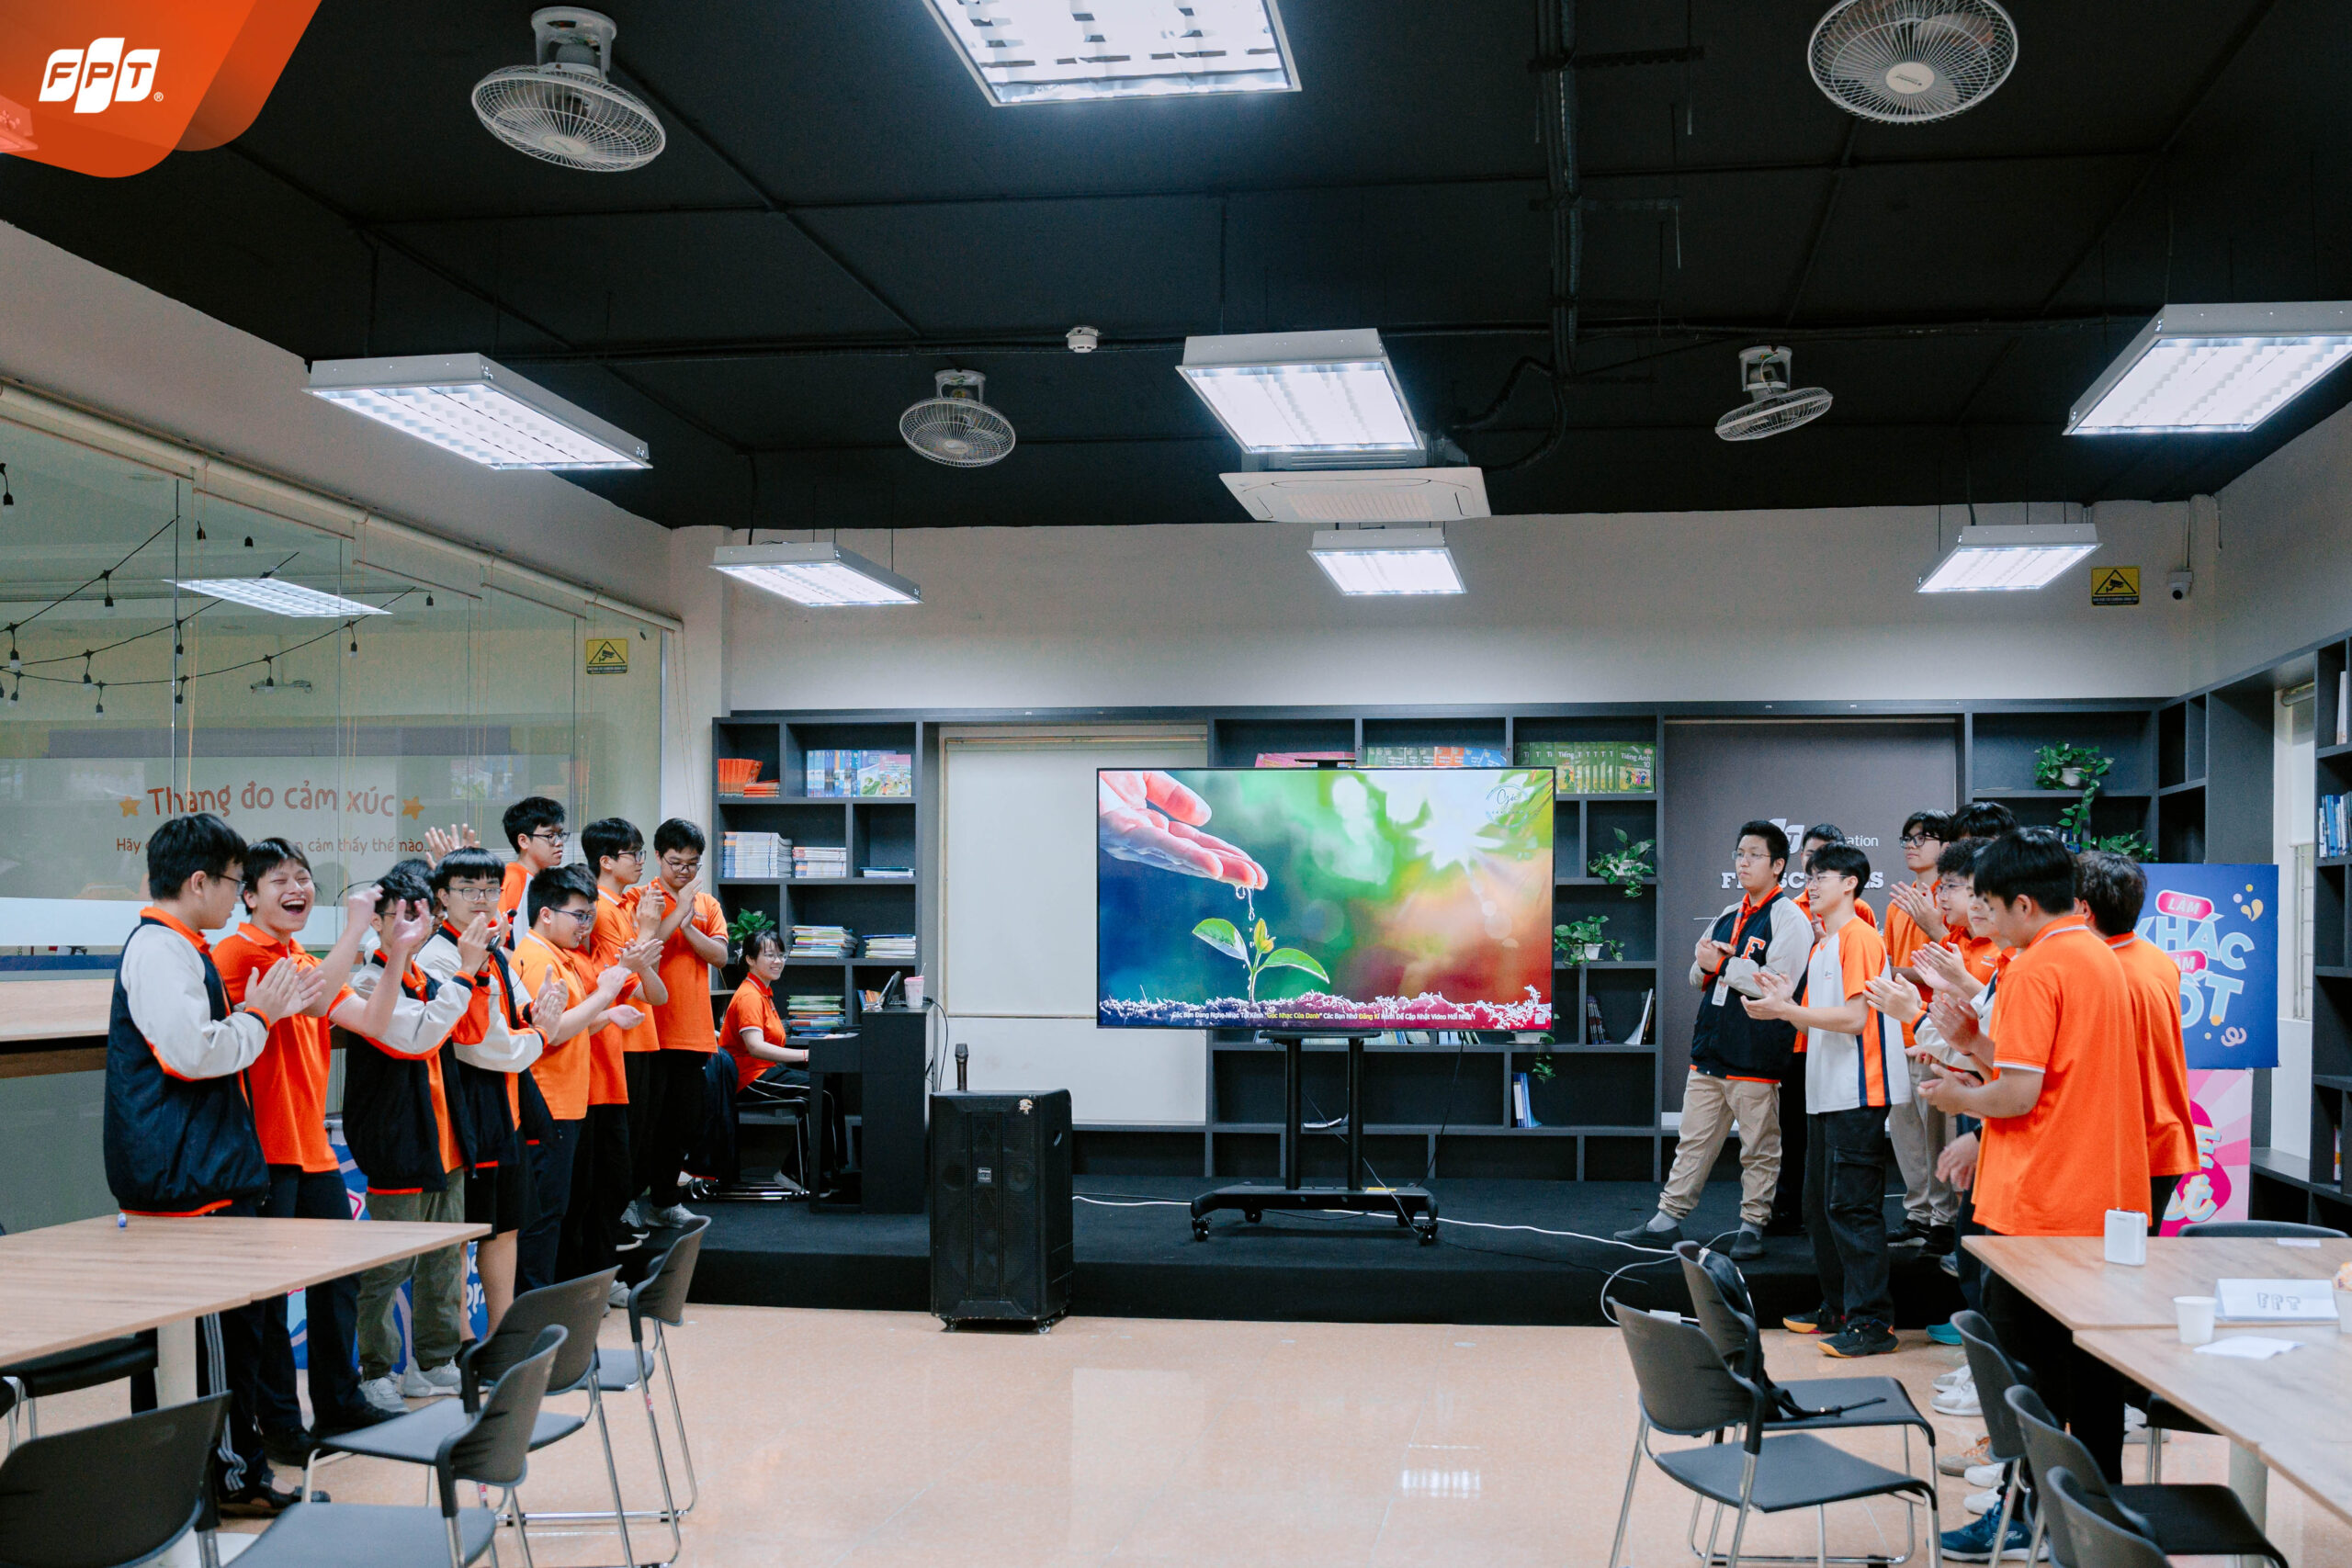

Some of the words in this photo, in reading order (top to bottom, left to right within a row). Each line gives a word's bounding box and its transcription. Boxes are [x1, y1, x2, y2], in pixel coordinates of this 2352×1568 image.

[147, 784, 232, 818] Thang
[241, 781, 275, 810] đo
[284, 780, 337, 810] cảm
[345, 785, 395, 817] xúc
[117, 838, 141, 854] Hãy
[308, 837, 334, 852] cảm
[338, 837, 368, 855] thấy
[372, 836, 395, 852] thế
[1844, 835, 1879, 847] ation
[2167, 897, 2201, 915] LÀM
[1741, 935, 1767, 960] F
[2179, 968, 2245, 1029] ỐT
